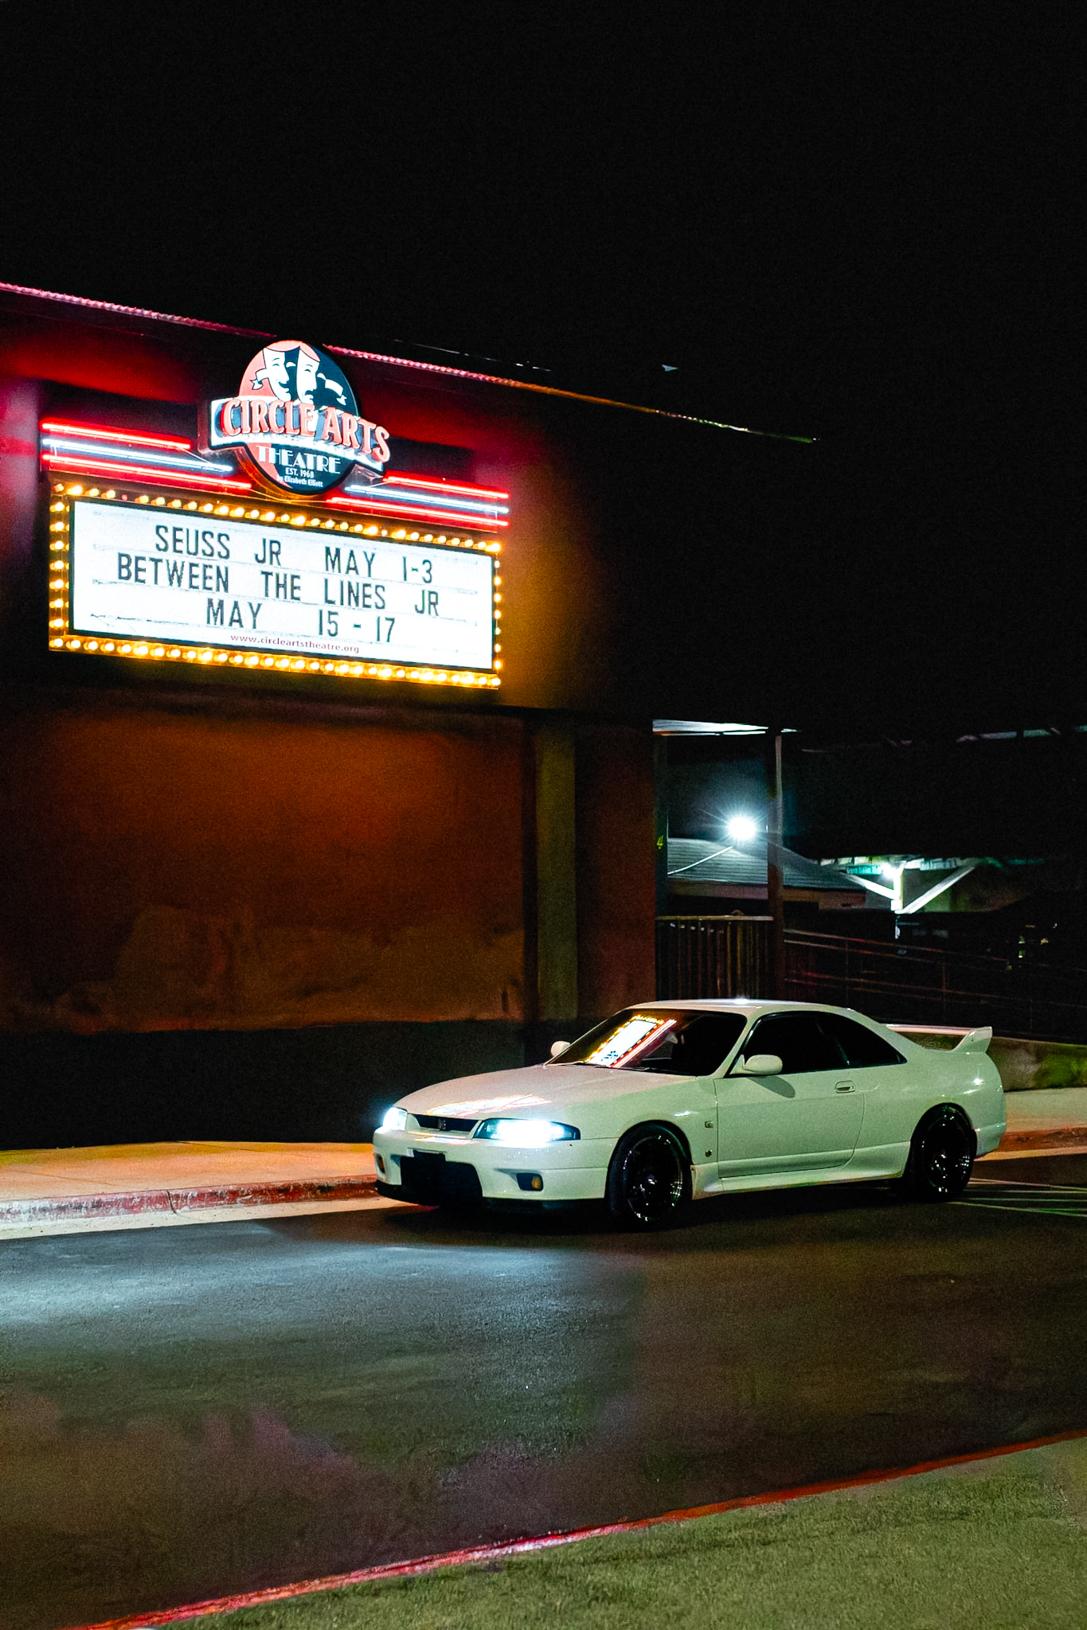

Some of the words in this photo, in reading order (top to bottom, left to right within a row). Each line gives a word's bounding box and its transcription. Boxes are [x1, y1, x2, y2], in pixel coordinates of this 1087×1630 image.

[220, 399, 316, 437] CIRCLE
[323, 406, 391, 463] ARTS
[256, 446, 341, 474] THEATRE
[285, 467, 298, 476] EST.
[155, 525, 230, 559] SEUSS
[254, 538, 281, 566] JR
[324, 546, 376, 577] MAY
[402, 556, 433, 584] 1-3
[117, 552, 229, 593] BETWEEN
[260, 570, 301, 601] THE
[324, 578, 386, 610] LINES
[414, 589, 439, 616] JR
[206, 598, 262, 629] MAY
[230, 634, 360, 654] www.circleartstheatre.org
